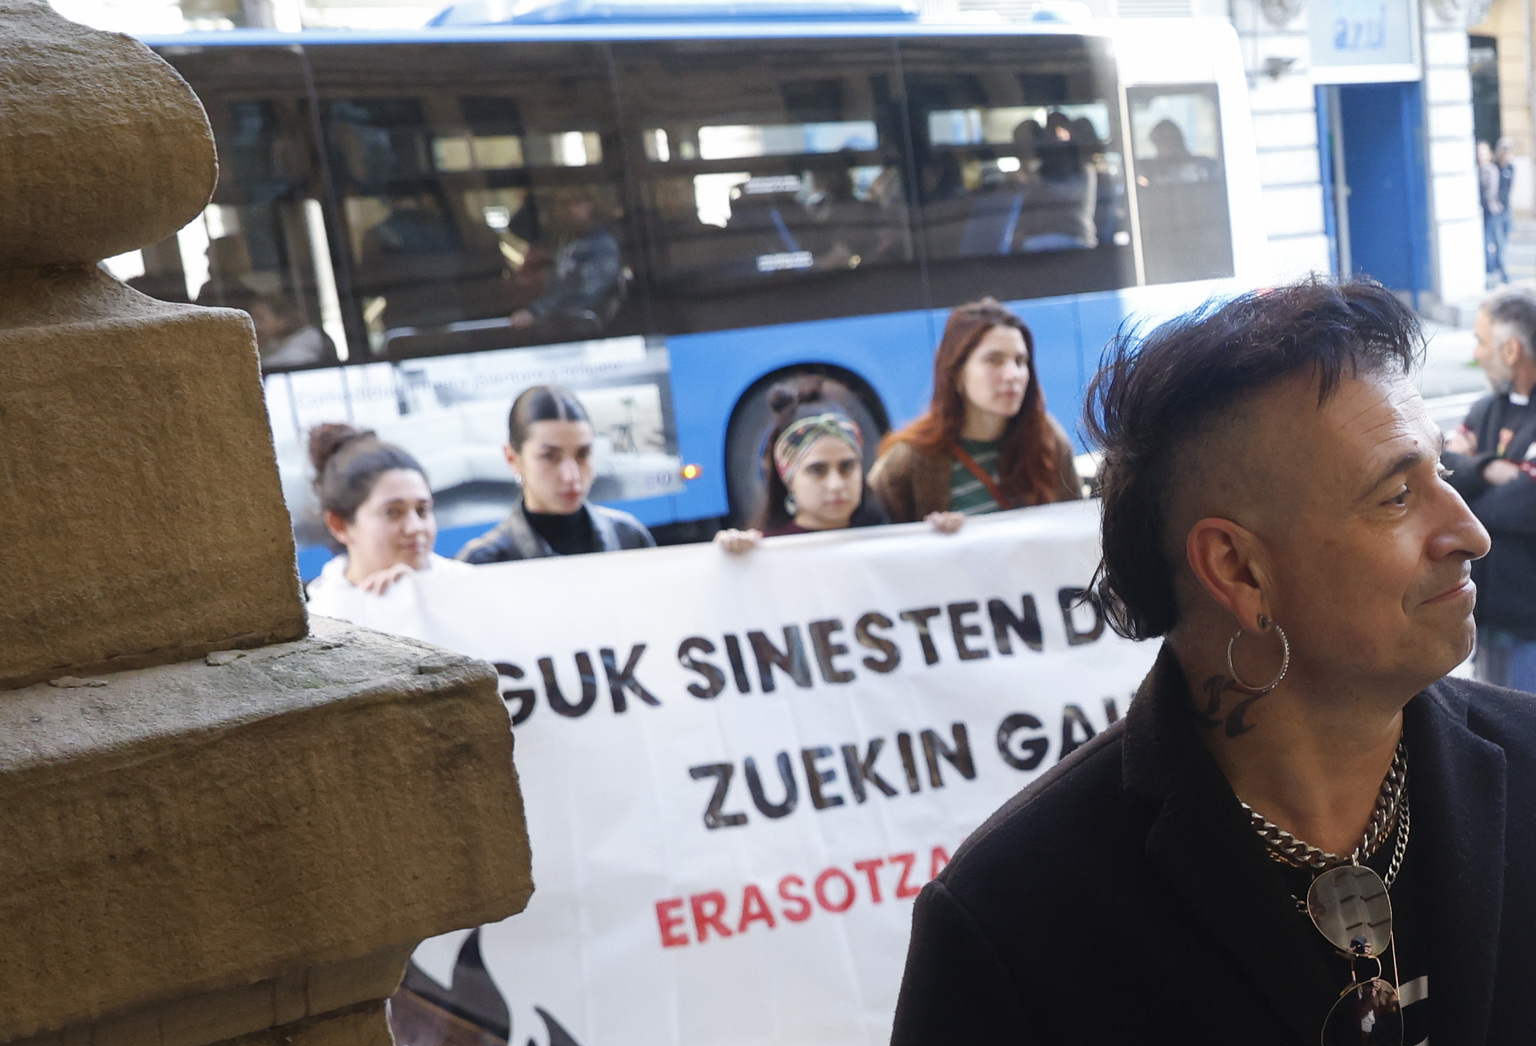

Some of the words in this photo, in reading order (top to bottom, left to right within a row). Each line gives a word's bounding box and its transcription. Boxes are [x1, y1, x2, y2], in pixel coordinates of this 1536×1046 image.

[494, 643, 661, 727] GUK
[677, 593, 1043, 699] SINESTEN
[688, 722, 977, 830] ZUEKIN
[997, 692, 1137, 772] GA
[655, 838, 966, 948] ERASOTZA
